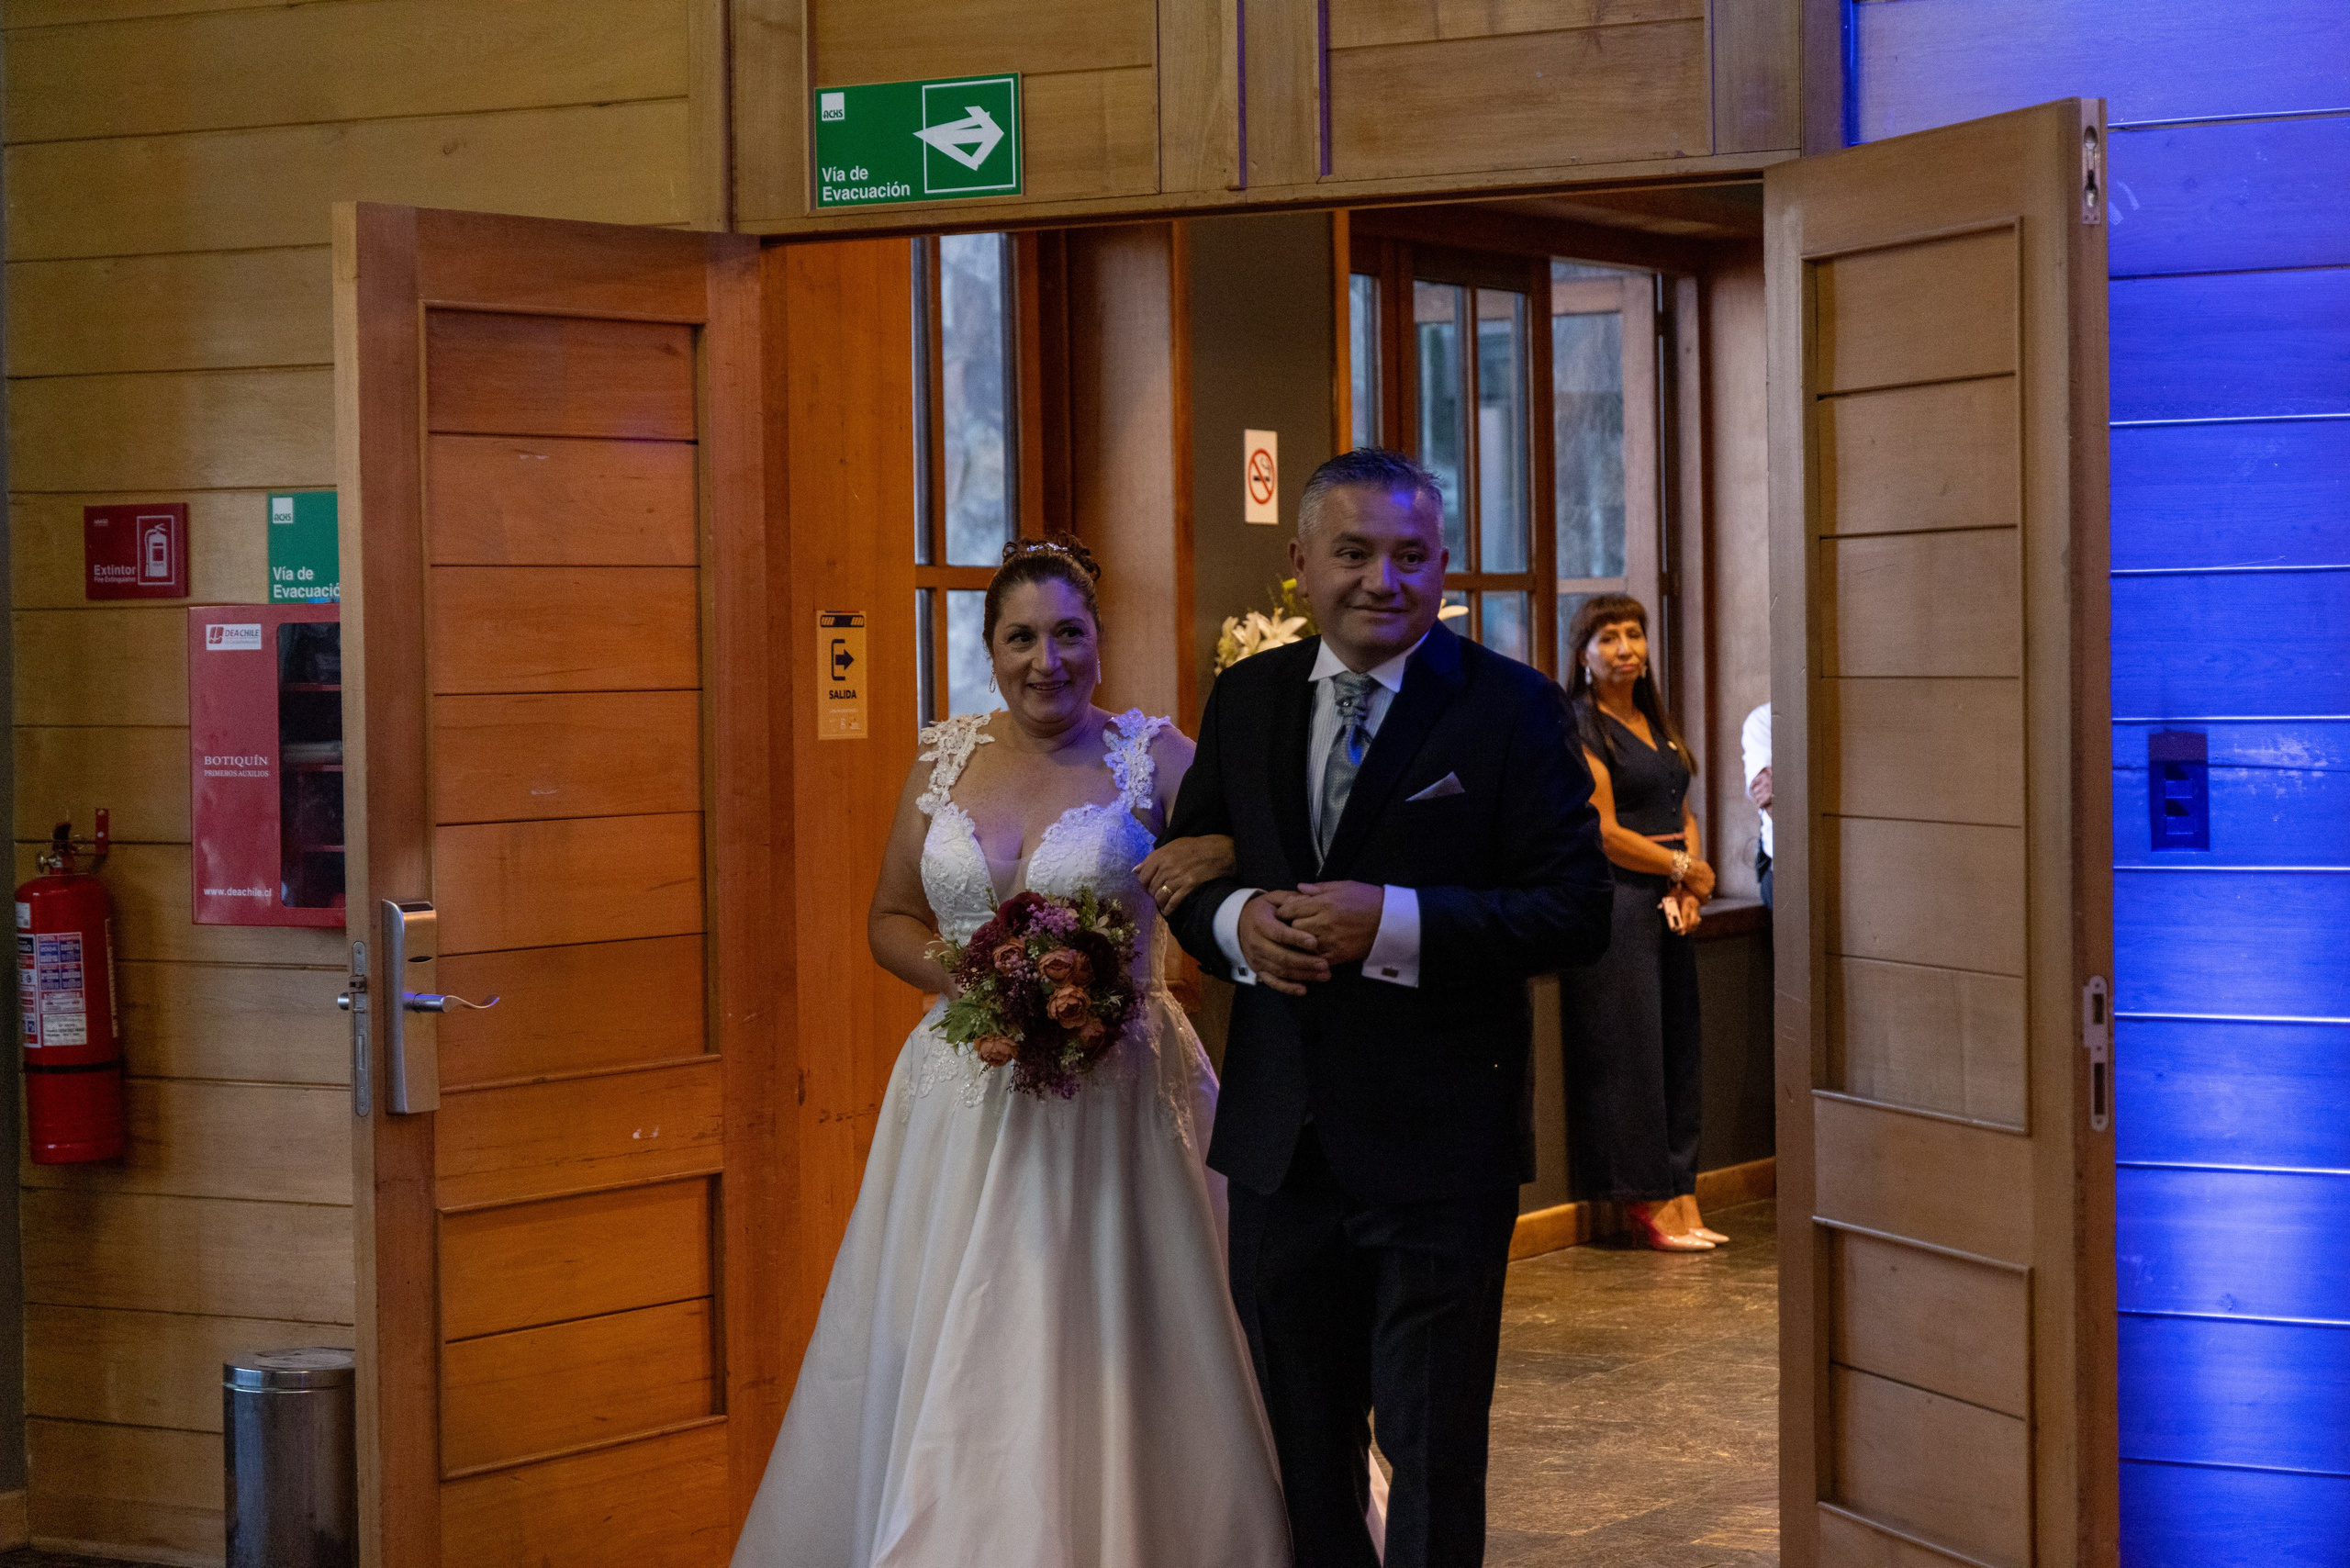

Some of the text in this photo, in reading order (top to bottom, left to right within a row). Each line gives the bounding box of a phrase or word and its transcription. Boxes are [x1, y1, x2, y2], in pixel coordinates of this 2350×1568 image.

[822, 109, 843, 119] ACHS
[822, 165, 868, 182] Vía de
[822, 181, 911, 201] Evacuación
[274, 513, 292, 521] ACHS
[94, 565, 137, 576] Extintor
[273, 566, 314, 580] Vía de
[274, 582, 340, 599] Evacuació
[829, 689, 856, 700] SALIDA
[204, 754, 268, 767] BOTIQUÍN
[203, 887, 273, 897] www.deachile.cl
